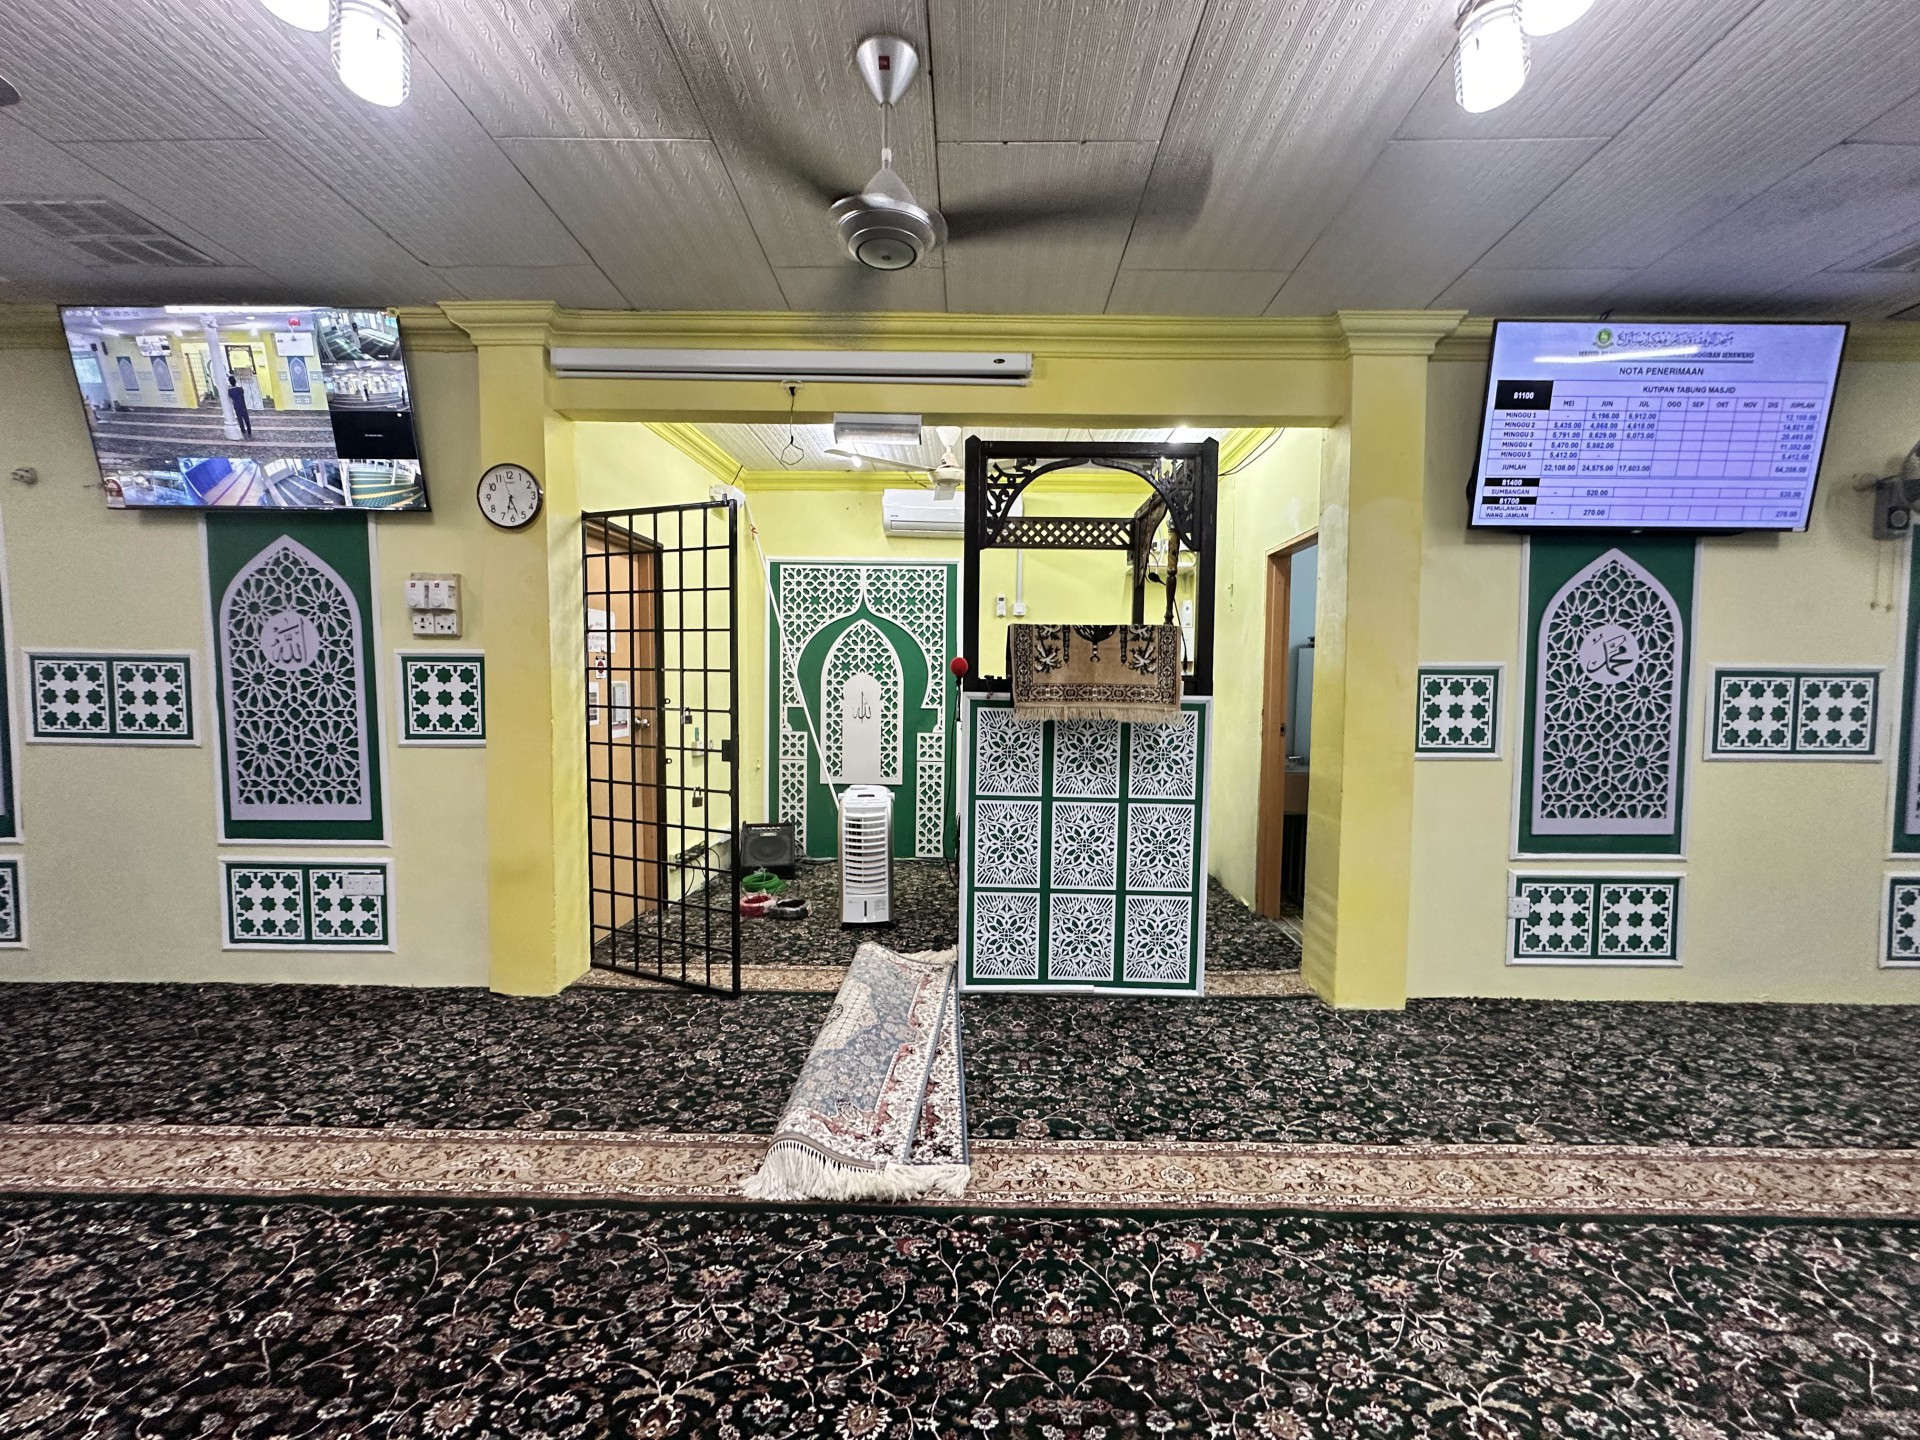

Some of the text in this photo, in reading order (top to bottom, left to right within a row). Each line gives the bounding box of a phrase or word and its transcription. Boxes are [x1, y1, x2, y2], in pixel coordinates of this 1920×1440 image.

[1619, 367, 1704, 376] NOTA PENERIMAAN
[1677, 386, 1706, 394] TABUNG
[495, 474, 502, 483] 11
[506, 471, 514, 480] 12
[519, 472, 522, 481] 1
[489, 483, 497, 492] 10
[526, 480, 532, 489] 2
[486, 493, 491, 502] 9
[531, 491, 536, 500] 3
[490, 505, 496, 513] 8
[500, 512, 506, 520] 7
[510, 514, 516, 522] 6
[521, 511, 527, 519] 5
